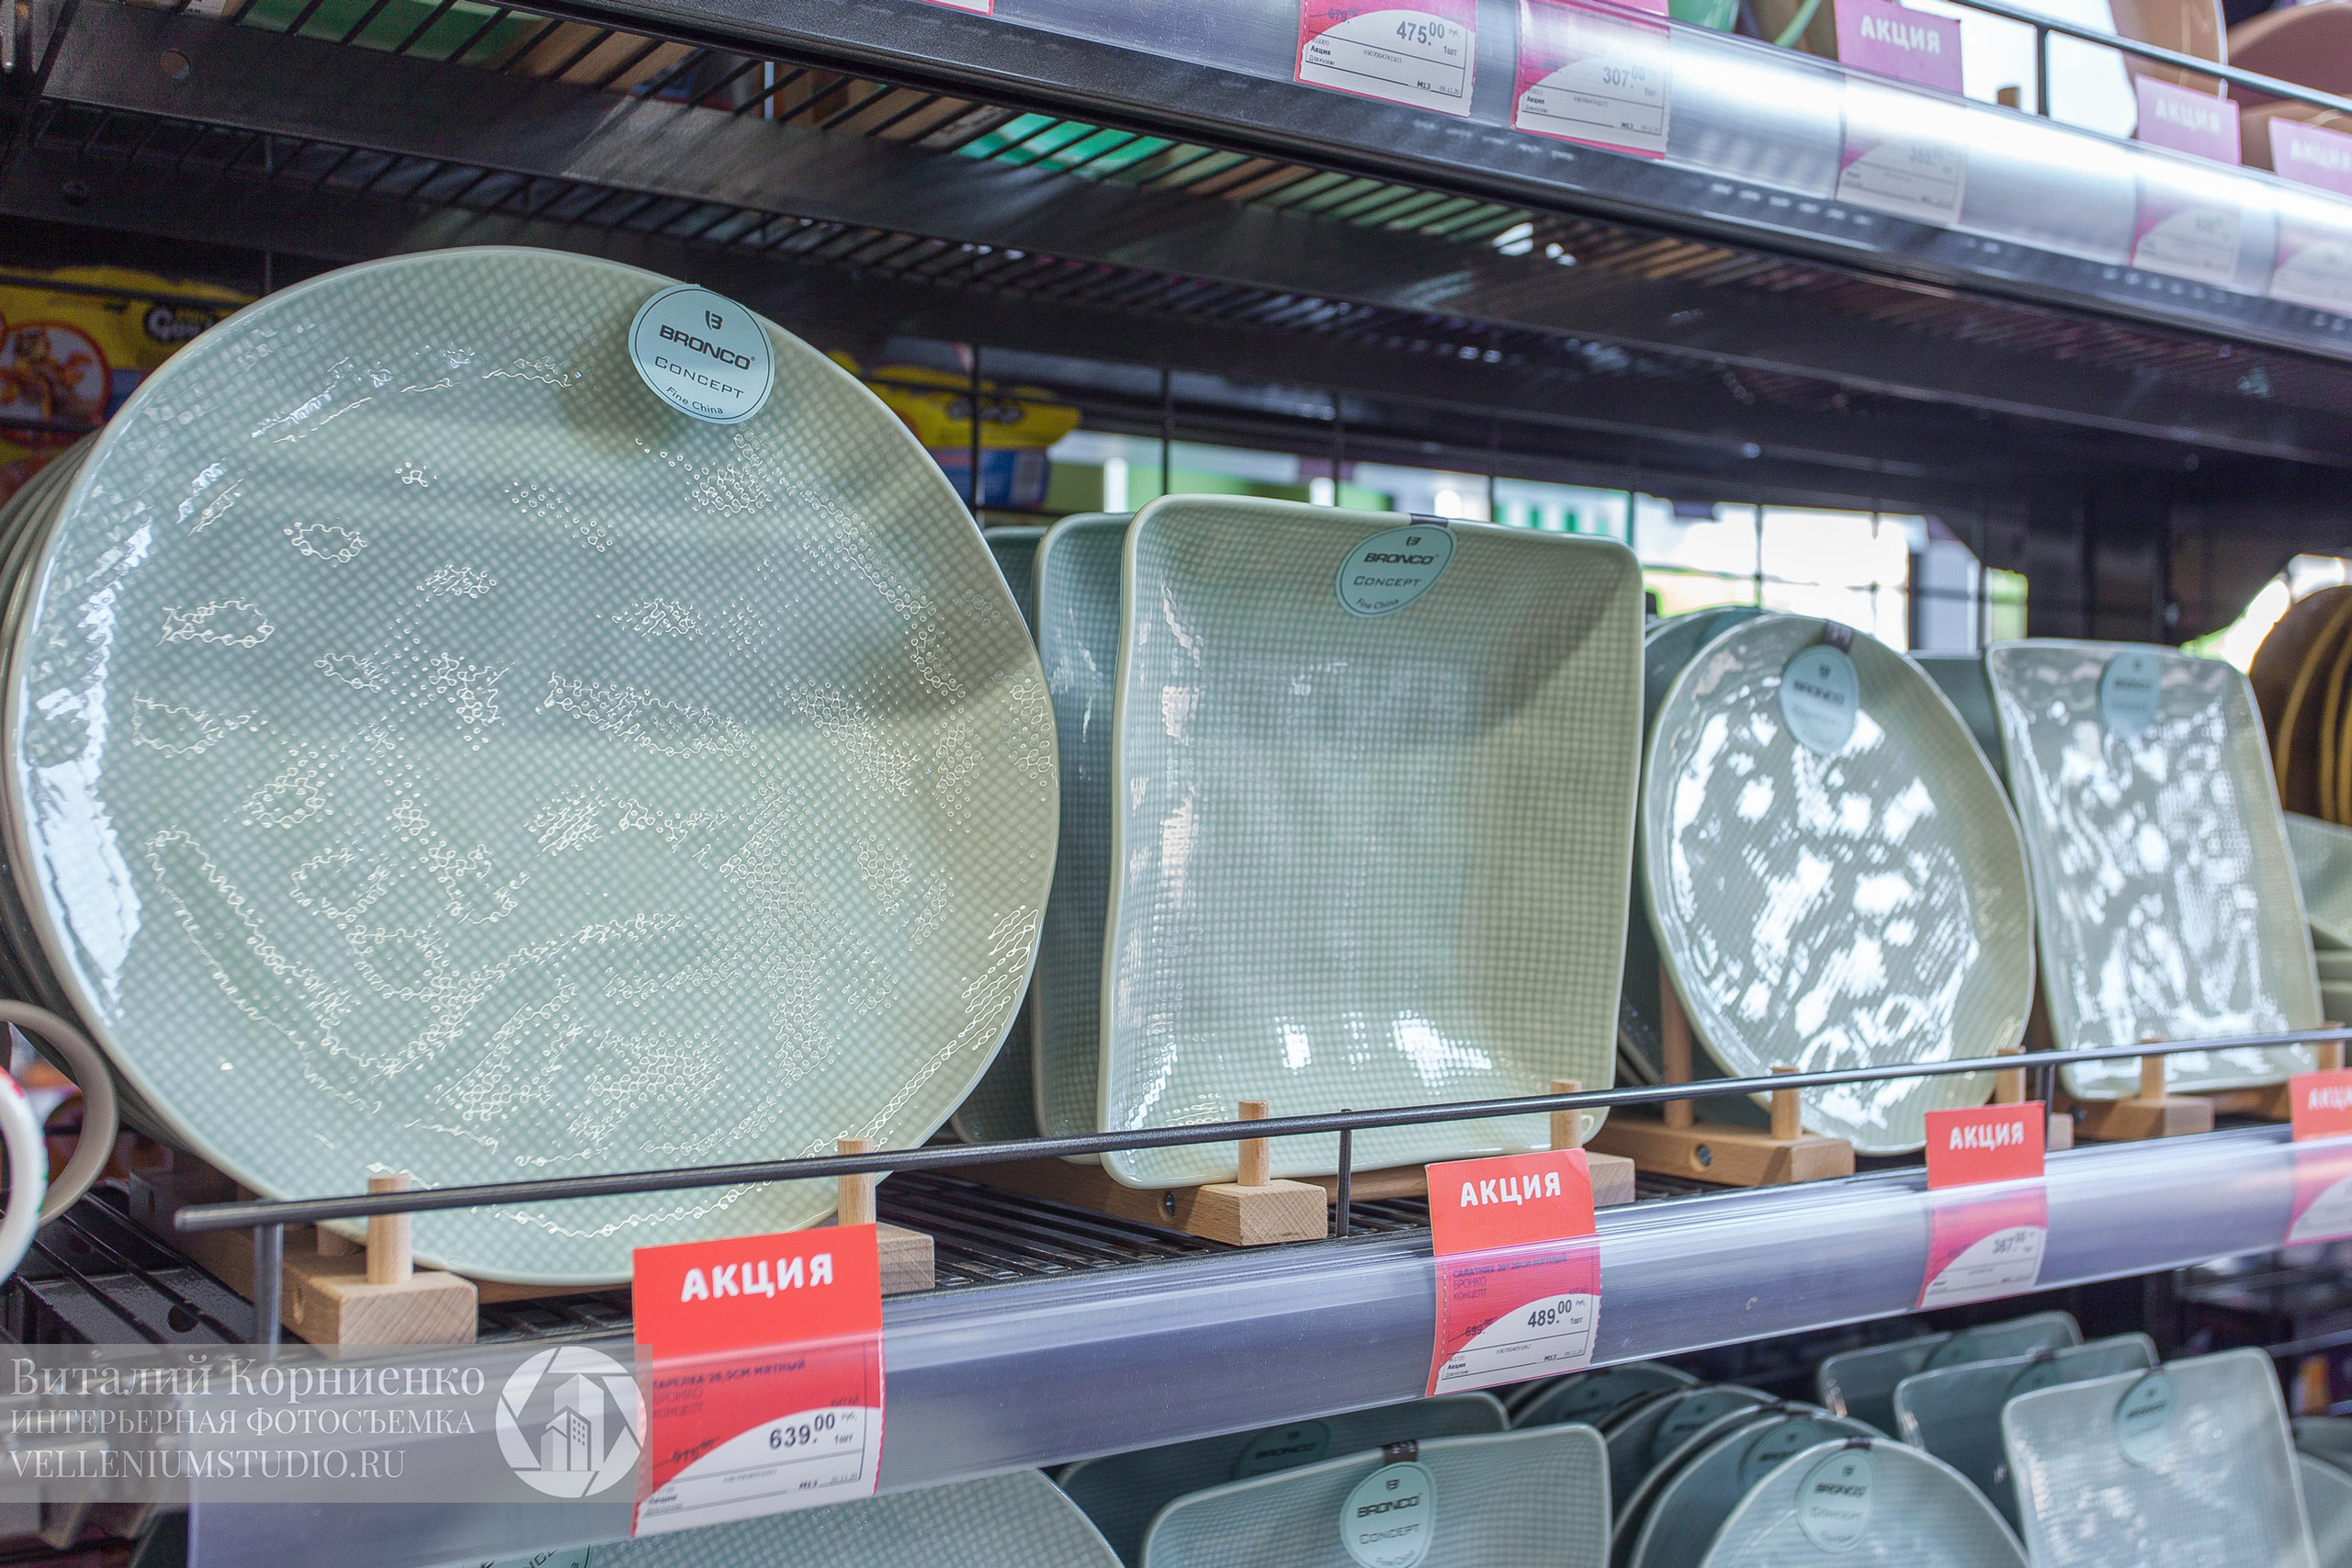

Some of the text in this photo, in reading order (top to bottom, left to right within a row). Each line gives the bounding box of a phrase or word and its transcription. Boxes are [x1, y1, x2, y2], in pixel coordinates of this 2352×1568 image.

[1396, 20, 1445, 46] 475.00
[1860, 14, 1942, 56] АКЦИЯ
[1310, 45, 1331, 56] Акция
[1442, 45, 1458, 57] 1шт
[659, 323, 752, 371] BRONCO
[654, 355, 744, 399] CONCEPT
[666, 386, 724, 414] Fine China
[1363, 552, 1434, 565] BRONCO
[1353, 575, 1421, 587] CONCEPT
[1949, 1121, 2025, 1153] АКЦИЯ
[1460, 1171, 1562, 1208] АКЦИЯ
[680, 1252, 833, 1303] АКЦИЯ
[1453, 1288, 1487, 1301] КОНЦЕПТ
[1527, 1299, 1572, 1328] 489.00
[1447, 1362, 1467, 1371] Акция
[769, 1413, 835, 1450] 639.00
[1357, 1495, 1419, 1517] BRONCO
[1359, 1524, 1419, 1544] CONCEPT
